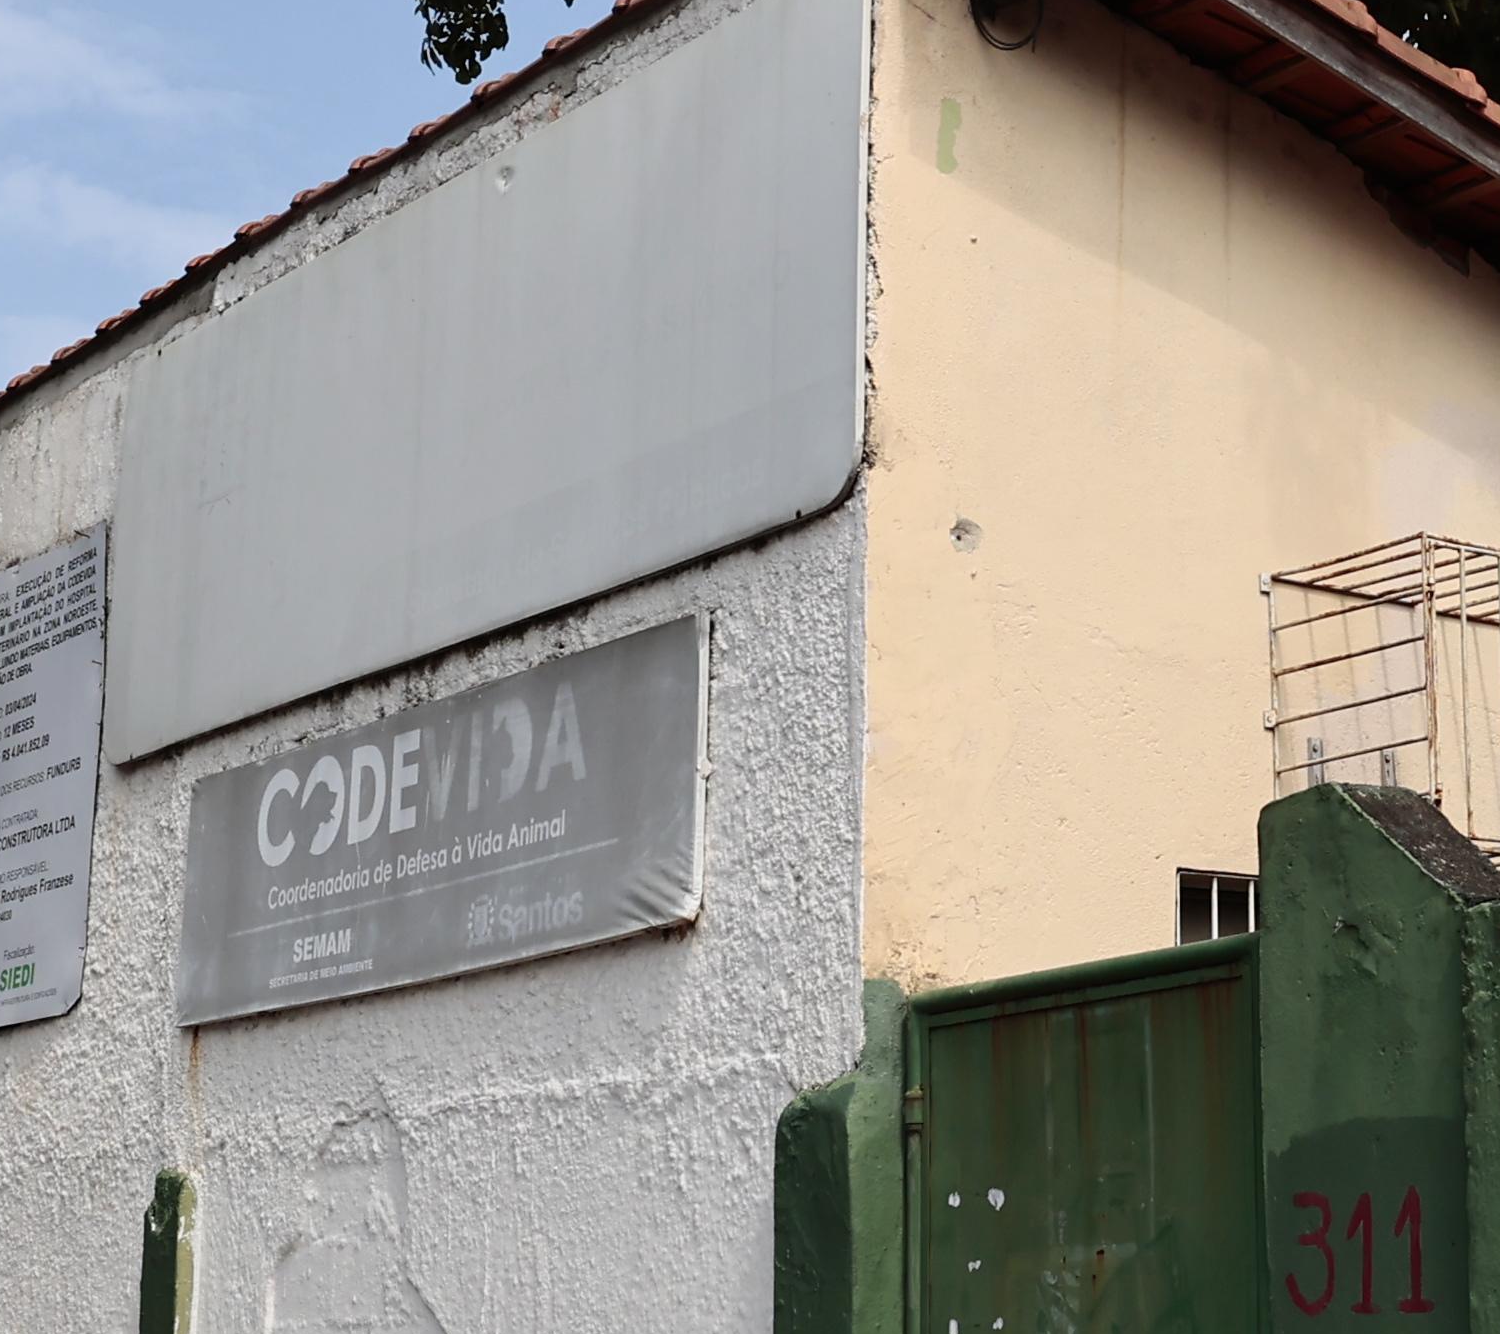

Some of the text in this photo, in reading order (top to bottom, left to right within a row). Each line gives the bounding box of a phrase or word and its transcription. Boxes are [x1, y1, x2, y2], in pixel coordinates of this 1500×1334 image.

[55, 565, 65, 579] DE
[57, 581, 66, 594] DA
[55, 598, 64, 612] DO
[32, 625, 41, 639] NA
[43, 617, 60, 634] ZONA
[6, 669, 15, 683] DE
[12, 716, 35, 735] MESES
[257, 681, 587, 868] CODEVIDA
[54, 814, 76, 834] LTDA
[268, 809, 567, 910] Coordenadoria de Defesa à Vida Animal
[1, 882, 38, 903] Rodrigues
[39, 873, 74, 893] Franzese
[500, 891, 584, 940] Santos
[293, 928, 351, 963] SEMAM
[0, 962, 36, 992] SIEDI
[269, 959, 373, 989] SECRETARIA DE MEIO AMBIENTE
[1285, 1184, 1436, 1316] 311
